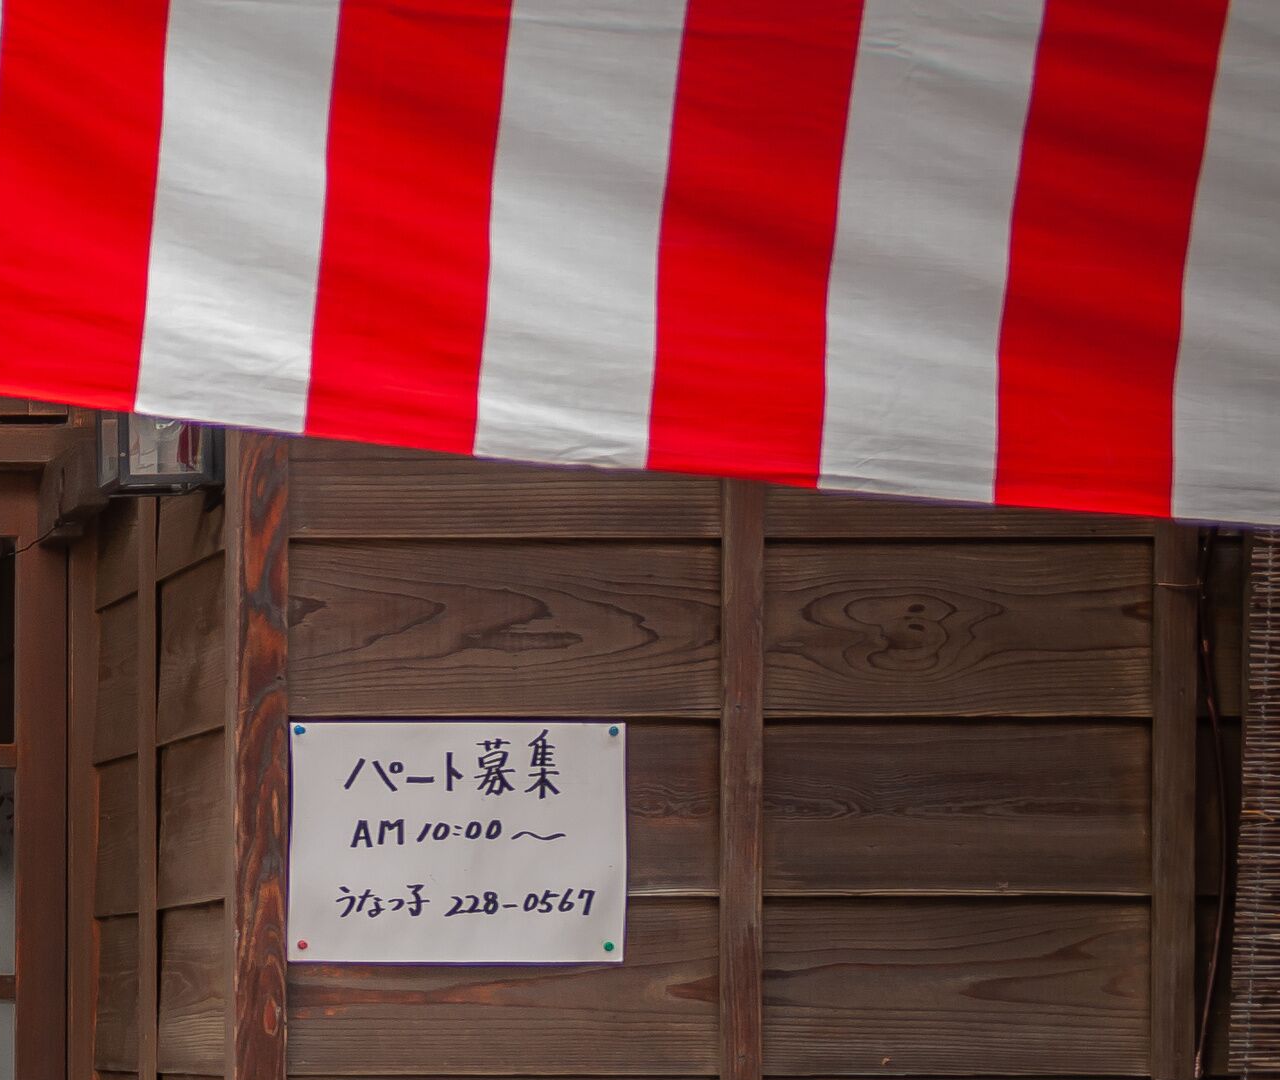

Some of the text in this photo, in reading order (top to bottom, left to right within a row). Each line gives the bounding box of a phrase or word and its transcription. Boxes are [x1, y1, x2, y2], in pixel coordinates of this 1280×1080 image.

[343, 729, 561, 800] パート募集
[349, 818, 405, 848] AM
[335, 884, 596, 918] うなっ子 228-0567
